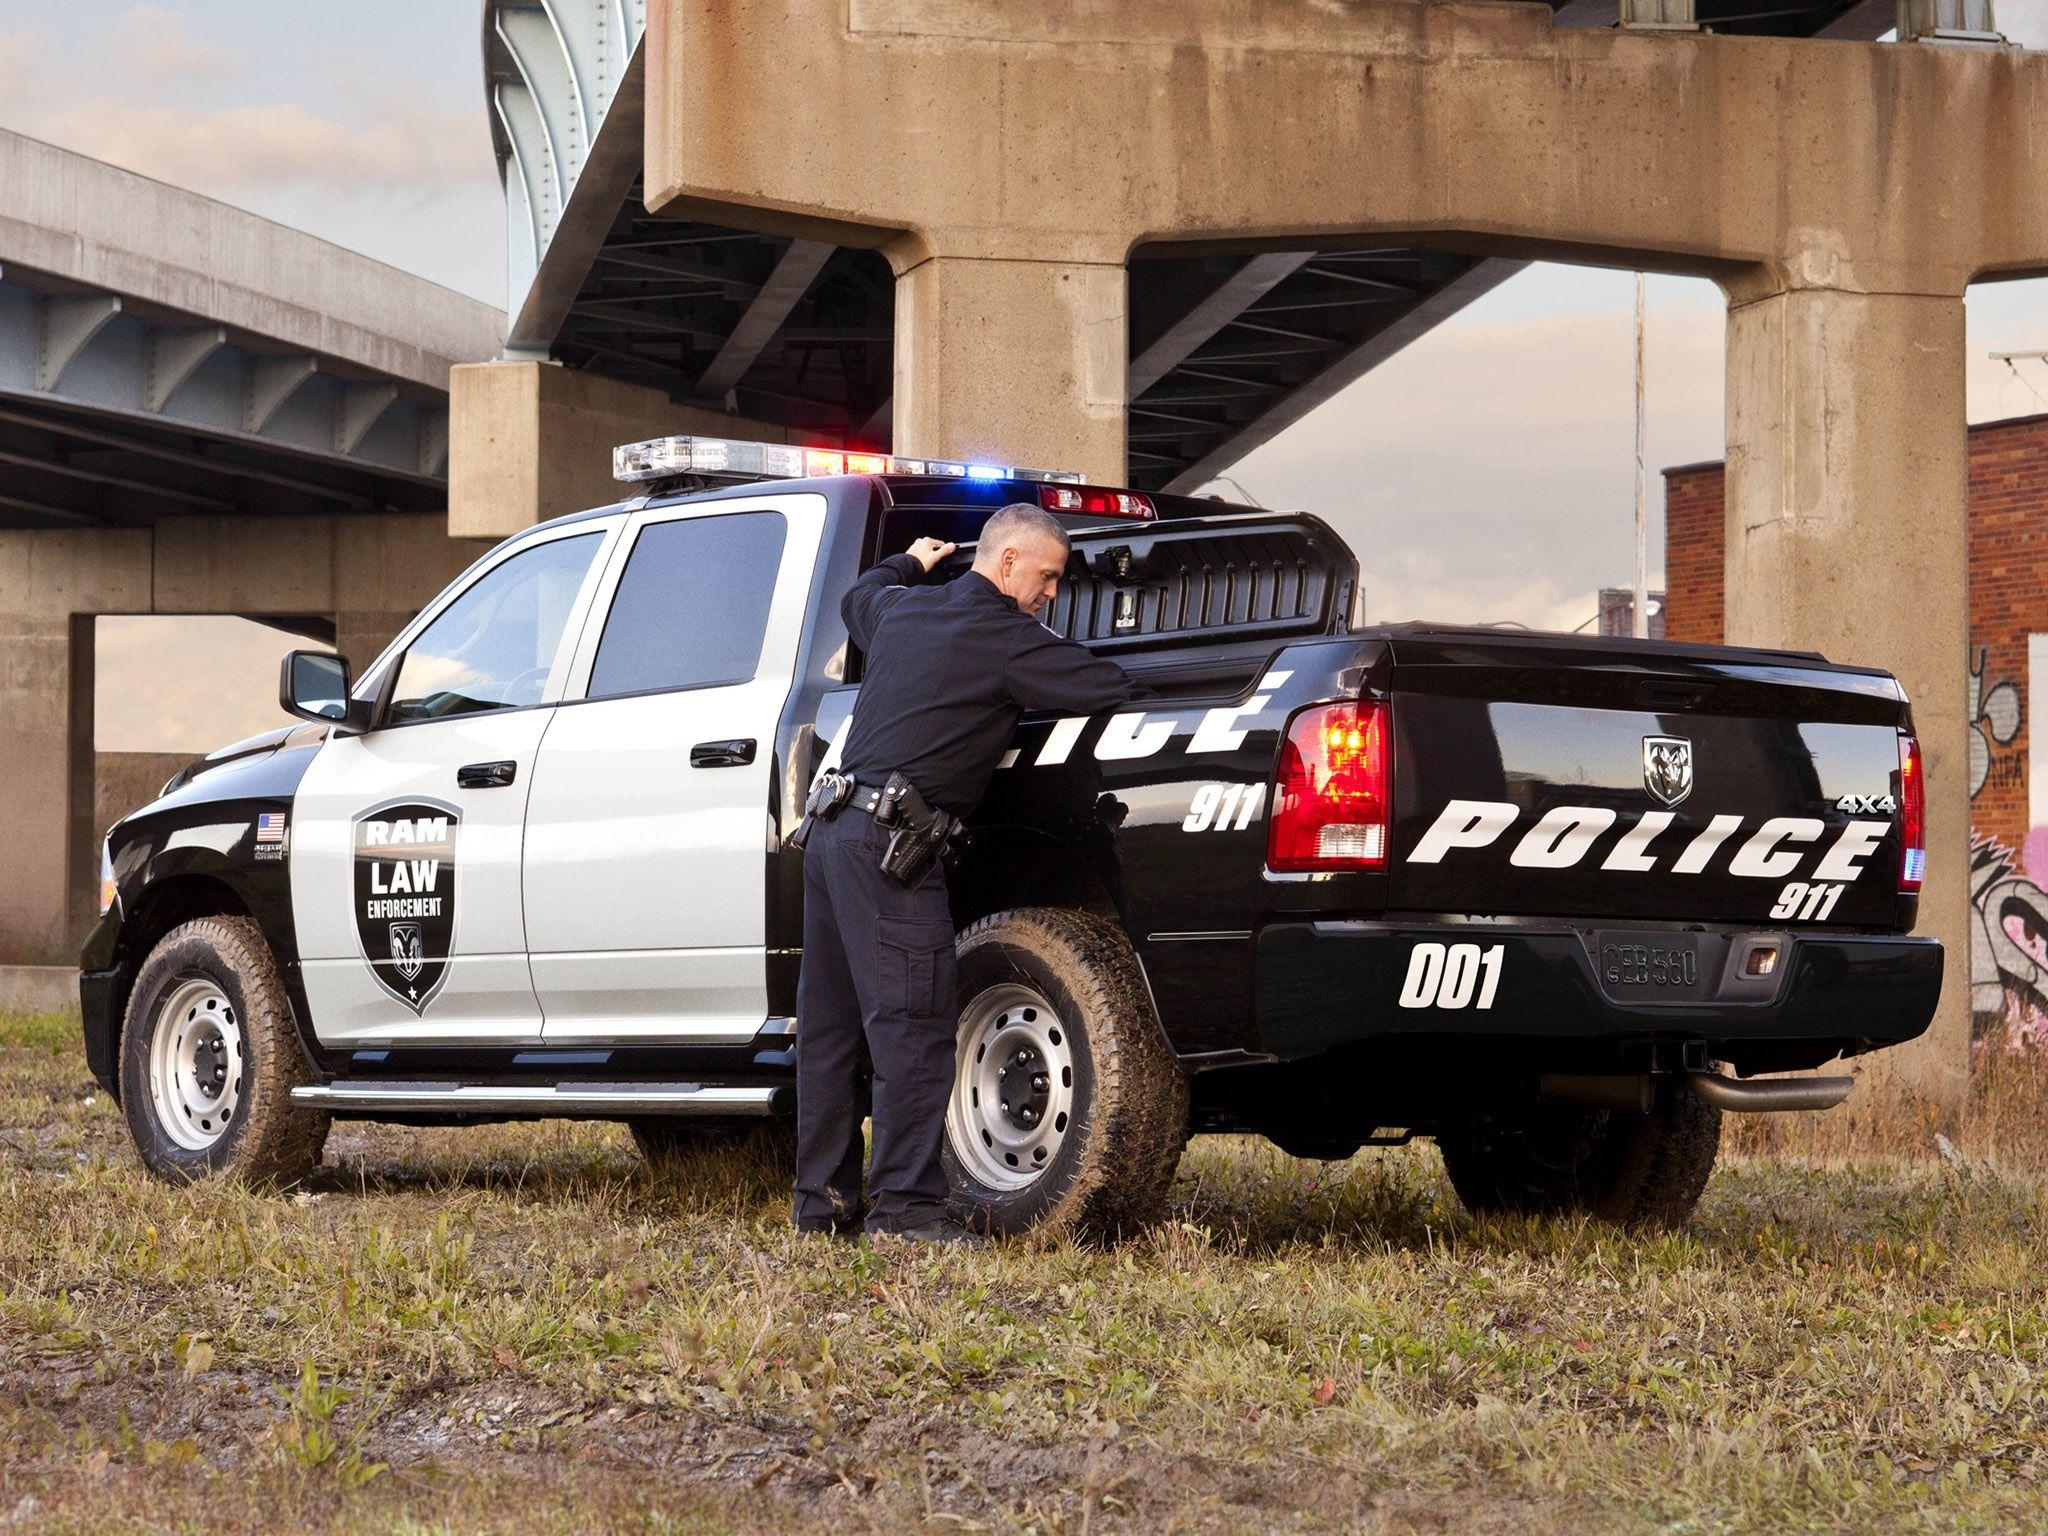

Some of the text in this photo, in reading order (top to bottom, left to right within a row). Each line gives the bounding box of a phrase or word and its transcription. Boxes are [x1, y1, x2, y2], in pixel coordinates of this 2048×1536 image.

[1182, 782, 1267, 833] 911
[366, 817, 448, 846] RAM
[1406, 799, 1892, 882] POLICE
[371, 859, 439, 895] LAW
[367, 897, 442, 919] ENFORCEMENT
[1768, 882, 1845, 921] 911
[1398, 942, 1505, 1010] 001
